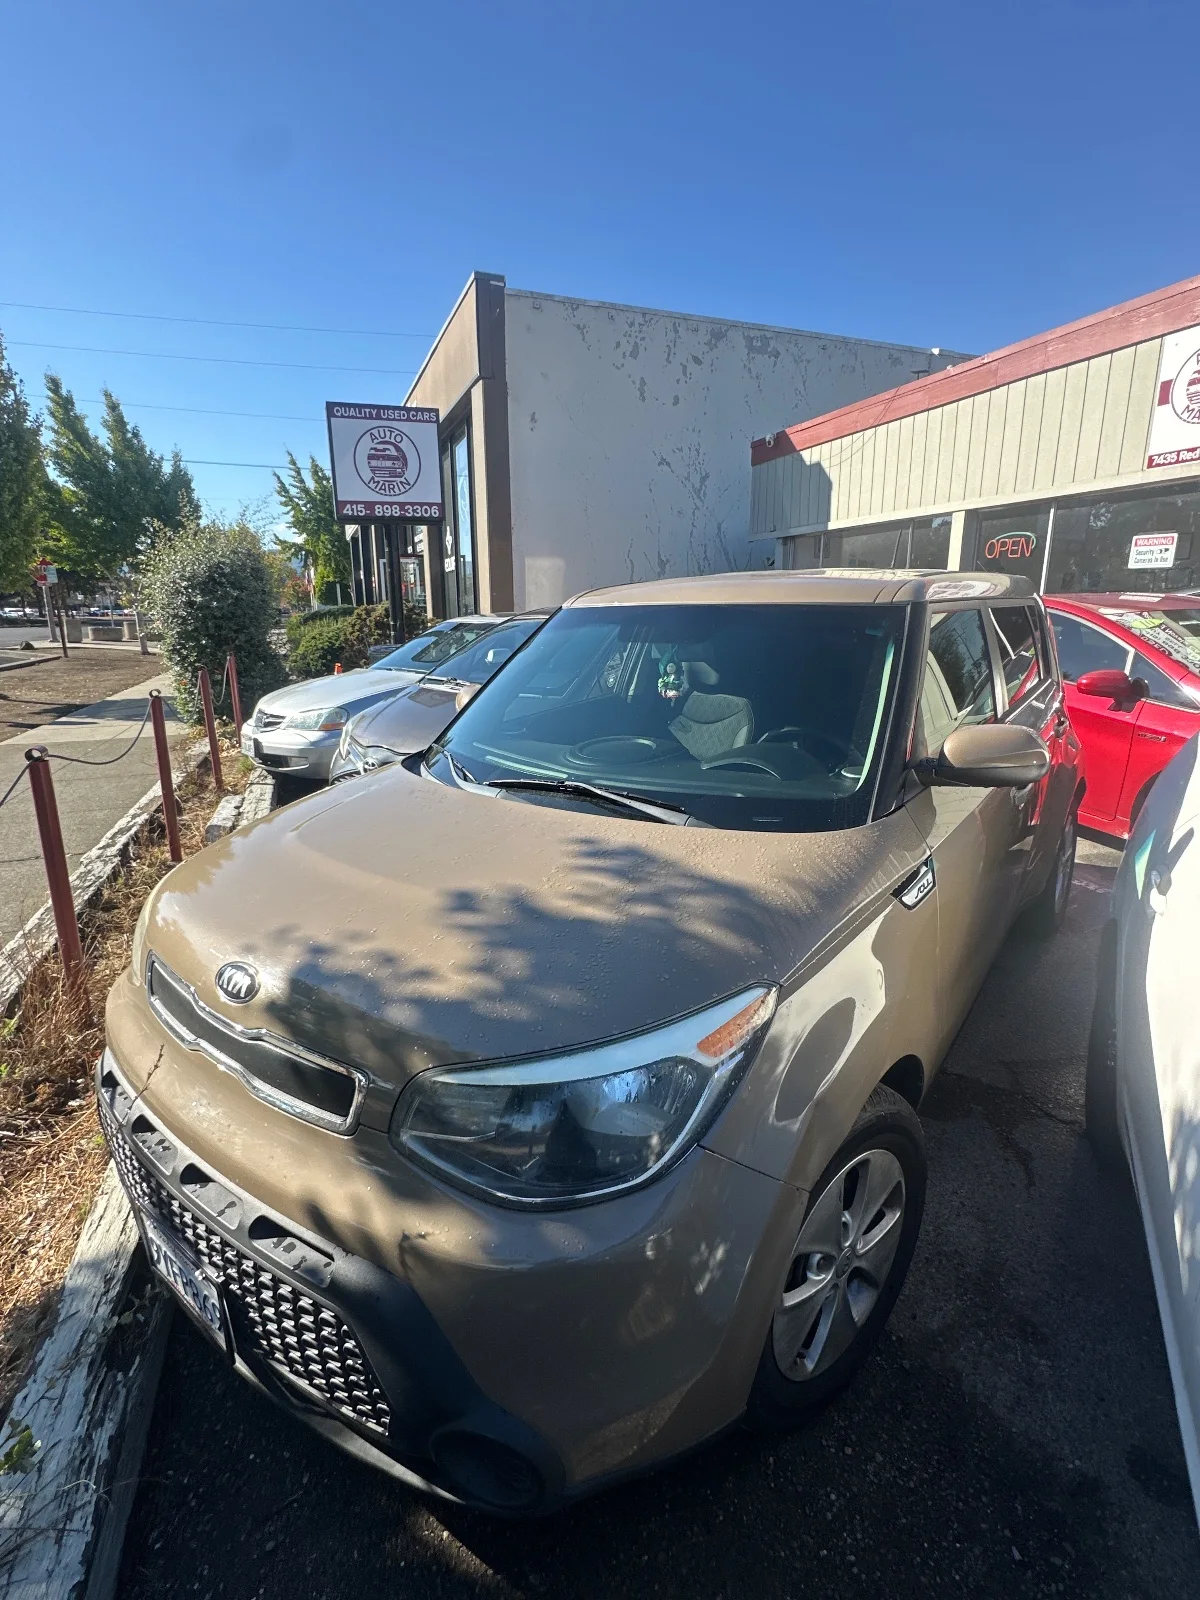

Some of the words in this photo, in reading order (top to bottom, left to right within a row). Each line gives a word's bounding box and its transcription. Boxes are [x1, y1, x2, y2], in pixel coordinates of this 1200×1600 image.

[333, 406, 377, 418] QUALITY
[380, 409, 408, 420] USED
[409, 411, 437, 421] CARS
[369, 428, 404, 444] AUTO
[1151, 452, 1178, 466] 7435
[367, 475, 412, 494] MARIN
[342, 503, 371, 516] 415-
[374, 504, 440, 517] 898-3306
[985, 537, 1033, 559] OPEN
[1136, 537, 1173, 546] WARNING
[1135, 548, 1155, 556] Security
